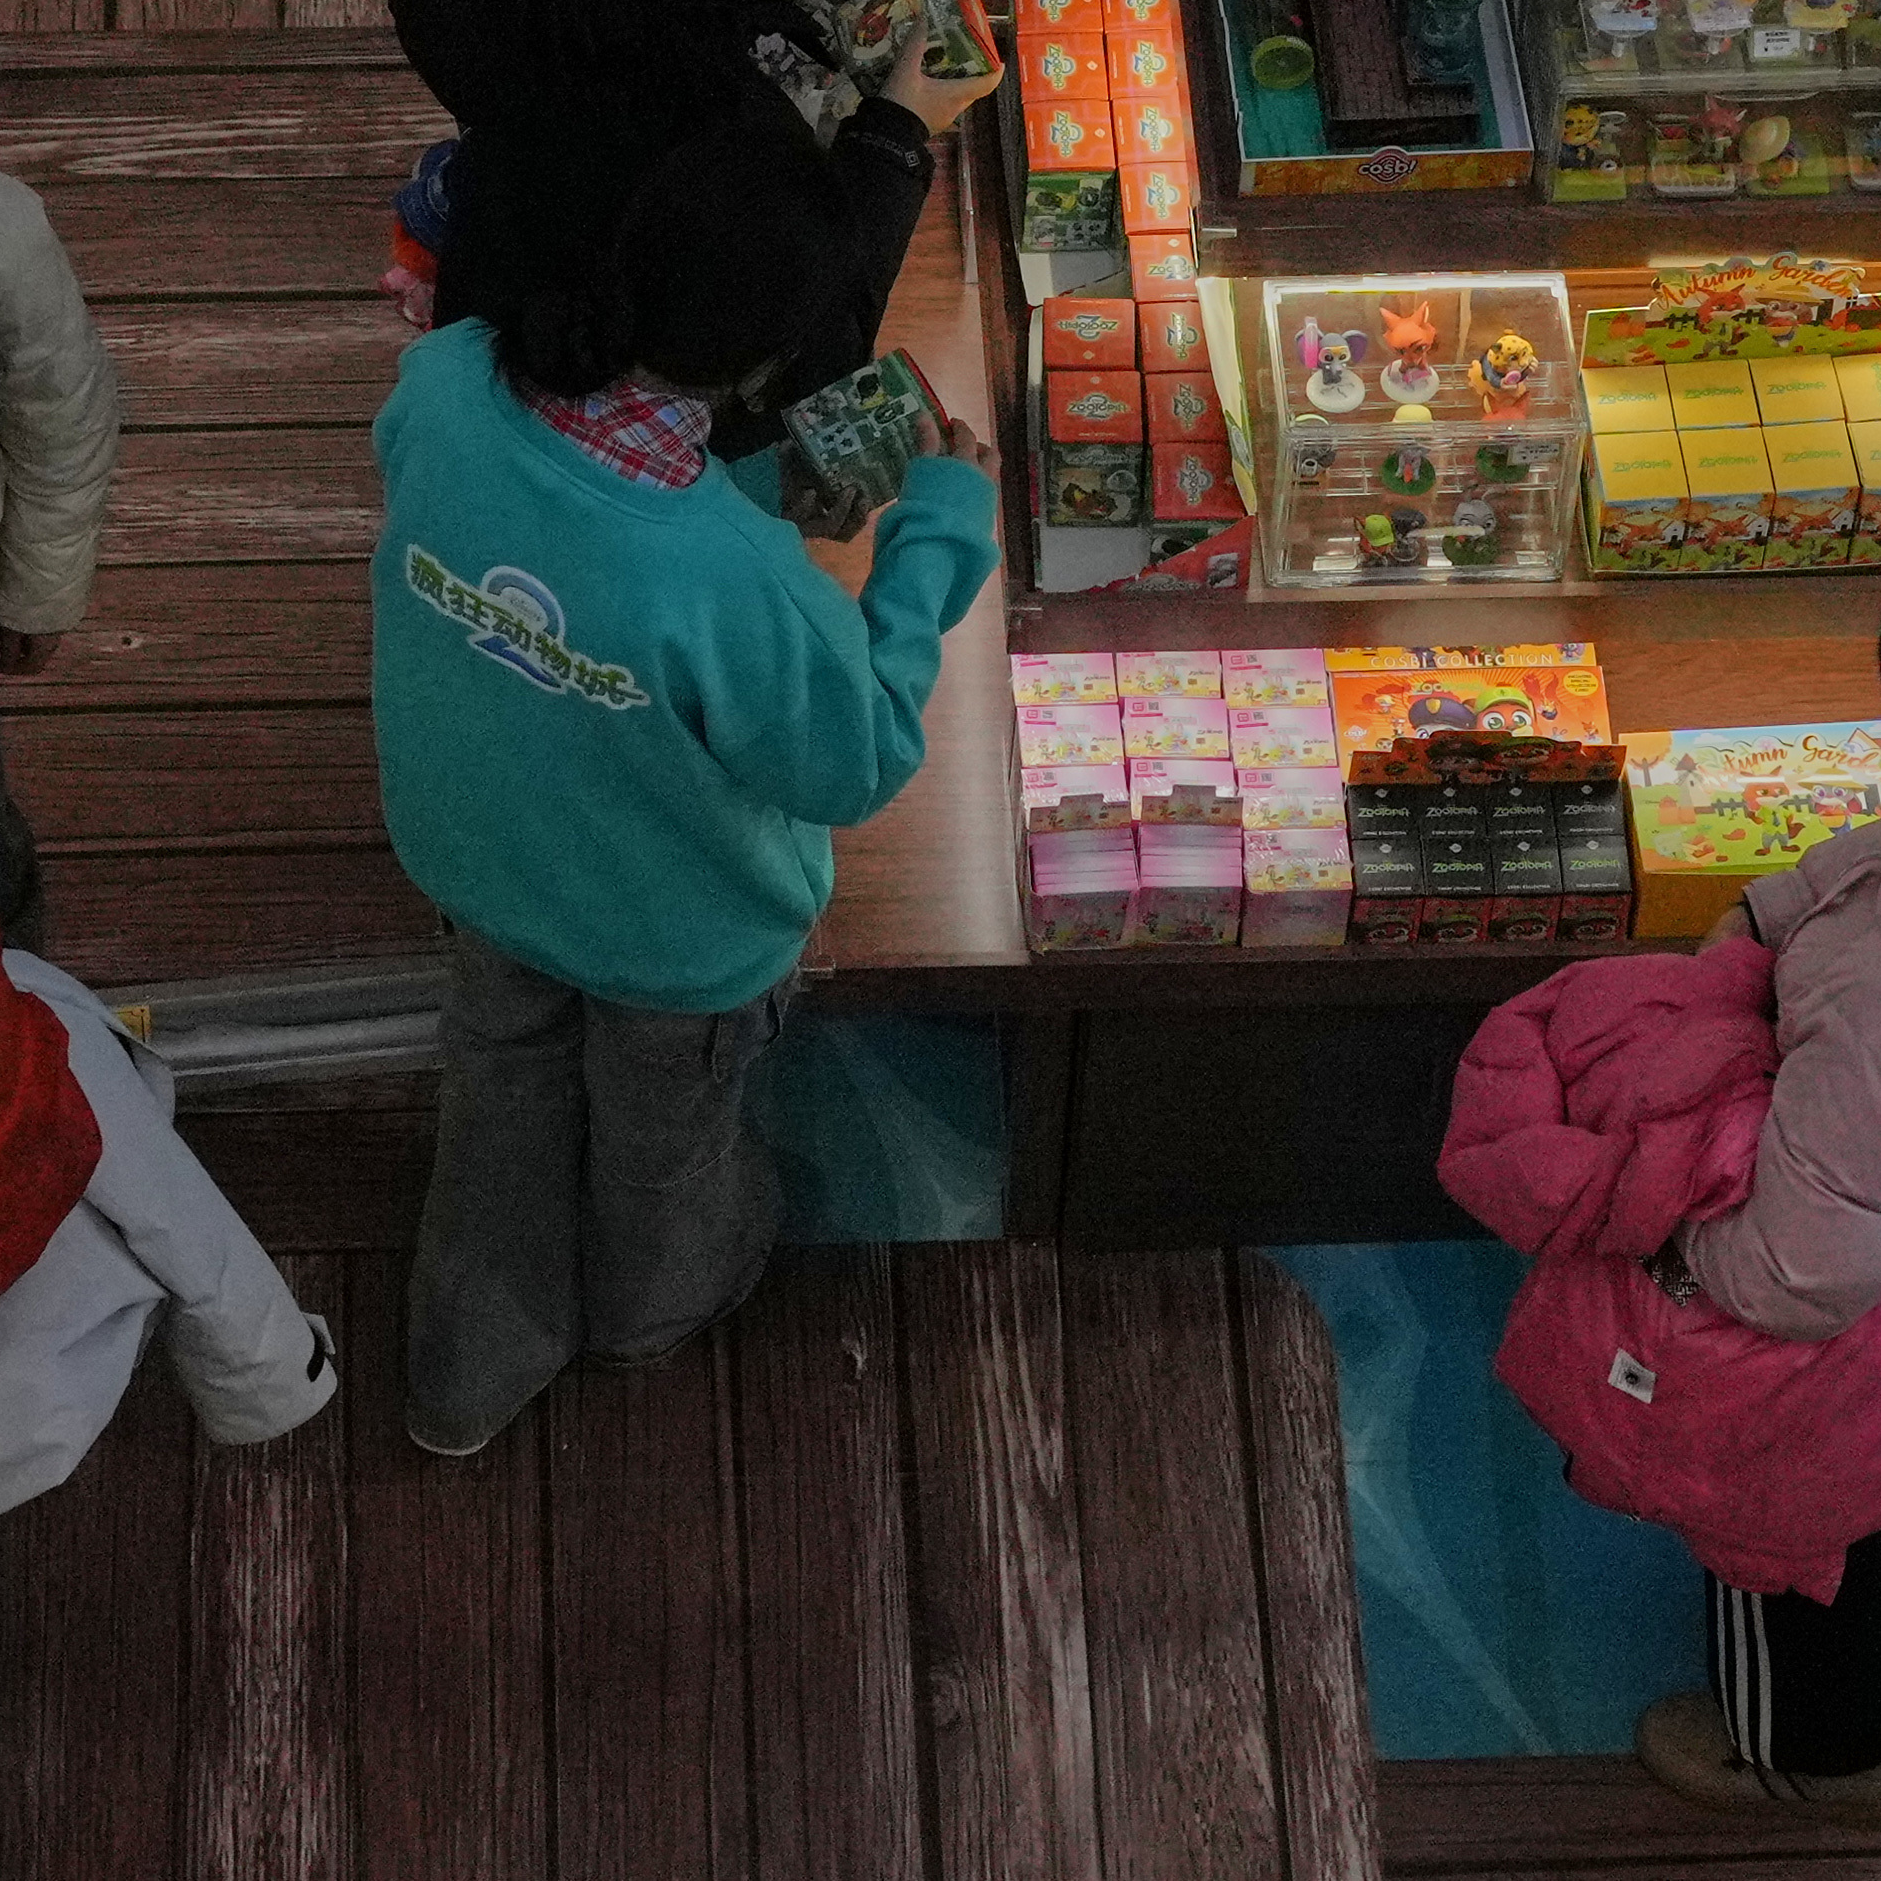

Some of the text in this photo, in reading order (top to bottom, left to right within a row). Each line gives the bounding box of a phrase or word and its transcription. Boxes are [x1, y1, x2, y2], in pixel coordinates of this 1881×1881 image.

[1662, 256, 1854, 310] Autumn Garden
[411, 553, 645, 704] 疯狂动物城
[1437, 653, 1553, 667] COLLECTION
